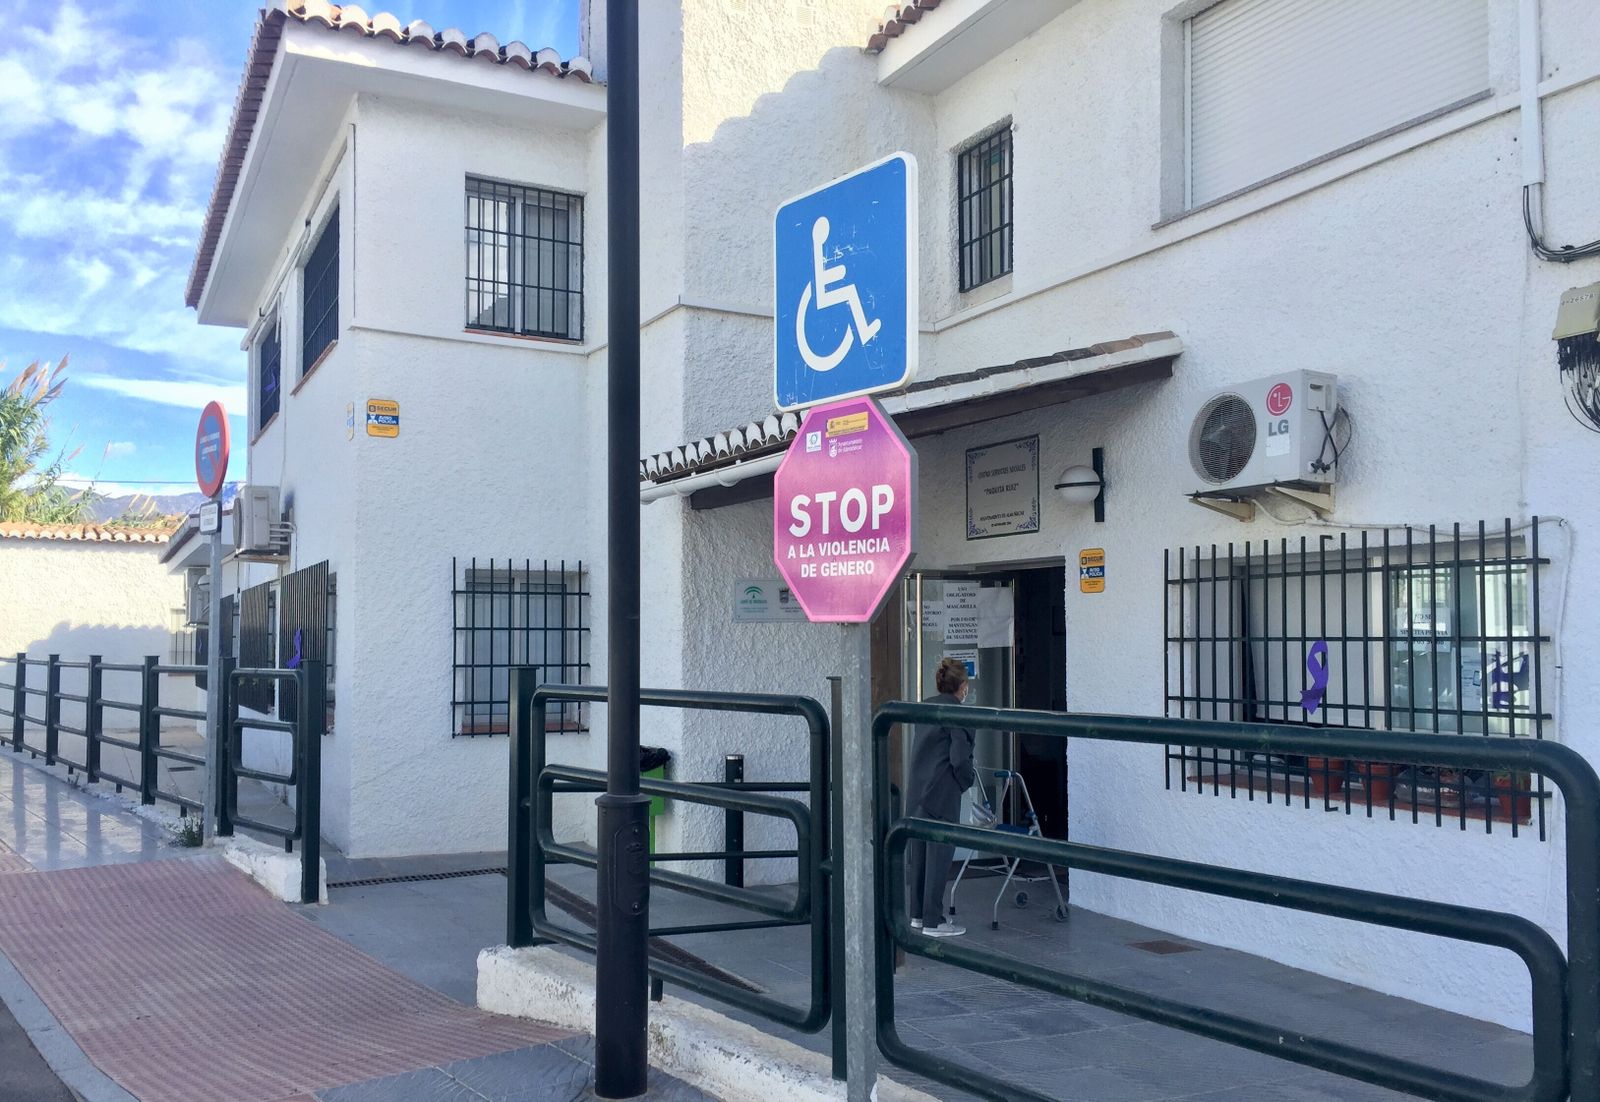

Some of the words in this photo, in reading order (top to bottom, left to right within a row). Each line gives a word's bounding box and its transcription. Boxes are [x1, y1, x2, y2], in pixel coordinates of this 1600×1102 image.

[1268, 419, 1289, 437] LG
[789, 484, 894, 537] STOP
[788, 545, 797, 559] A
[800, 544, 815, 558] LA
[818, 537, 890, 556] VIOLENCIA
[801, 563, 817, 578] DE
